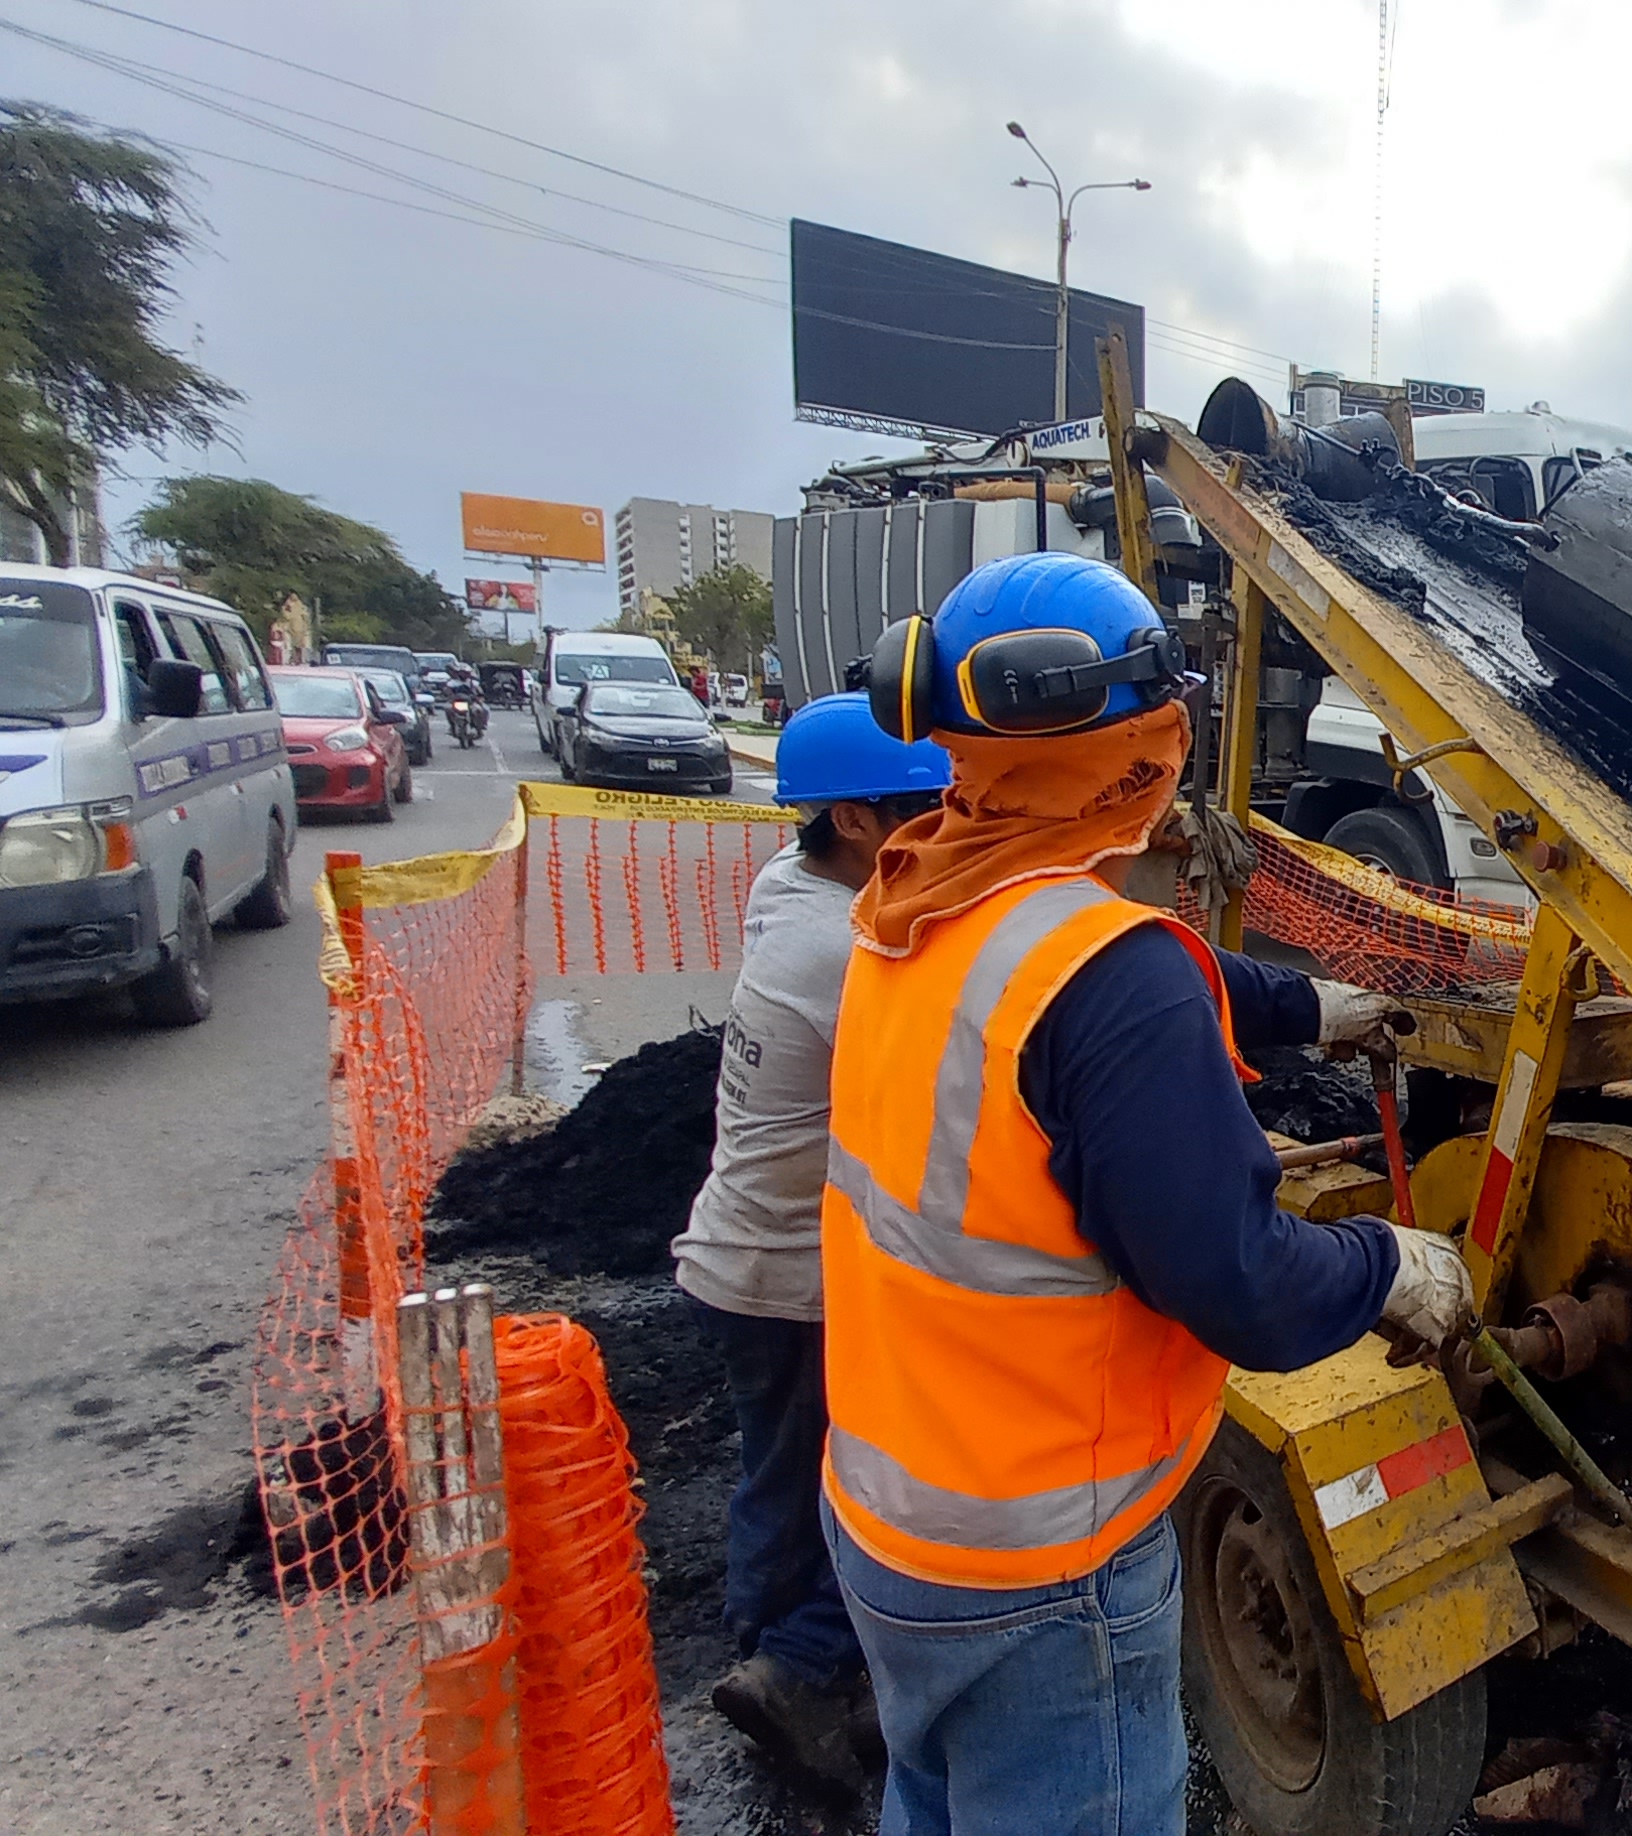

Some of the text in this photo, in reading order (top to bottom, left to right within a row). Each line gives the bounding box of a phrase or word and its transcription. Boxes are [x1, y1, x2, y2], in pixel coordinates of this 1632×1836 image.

[1408, 382, 1484, 409] PISO 5
[1032, 421, 1090, 451] AQUATECH
